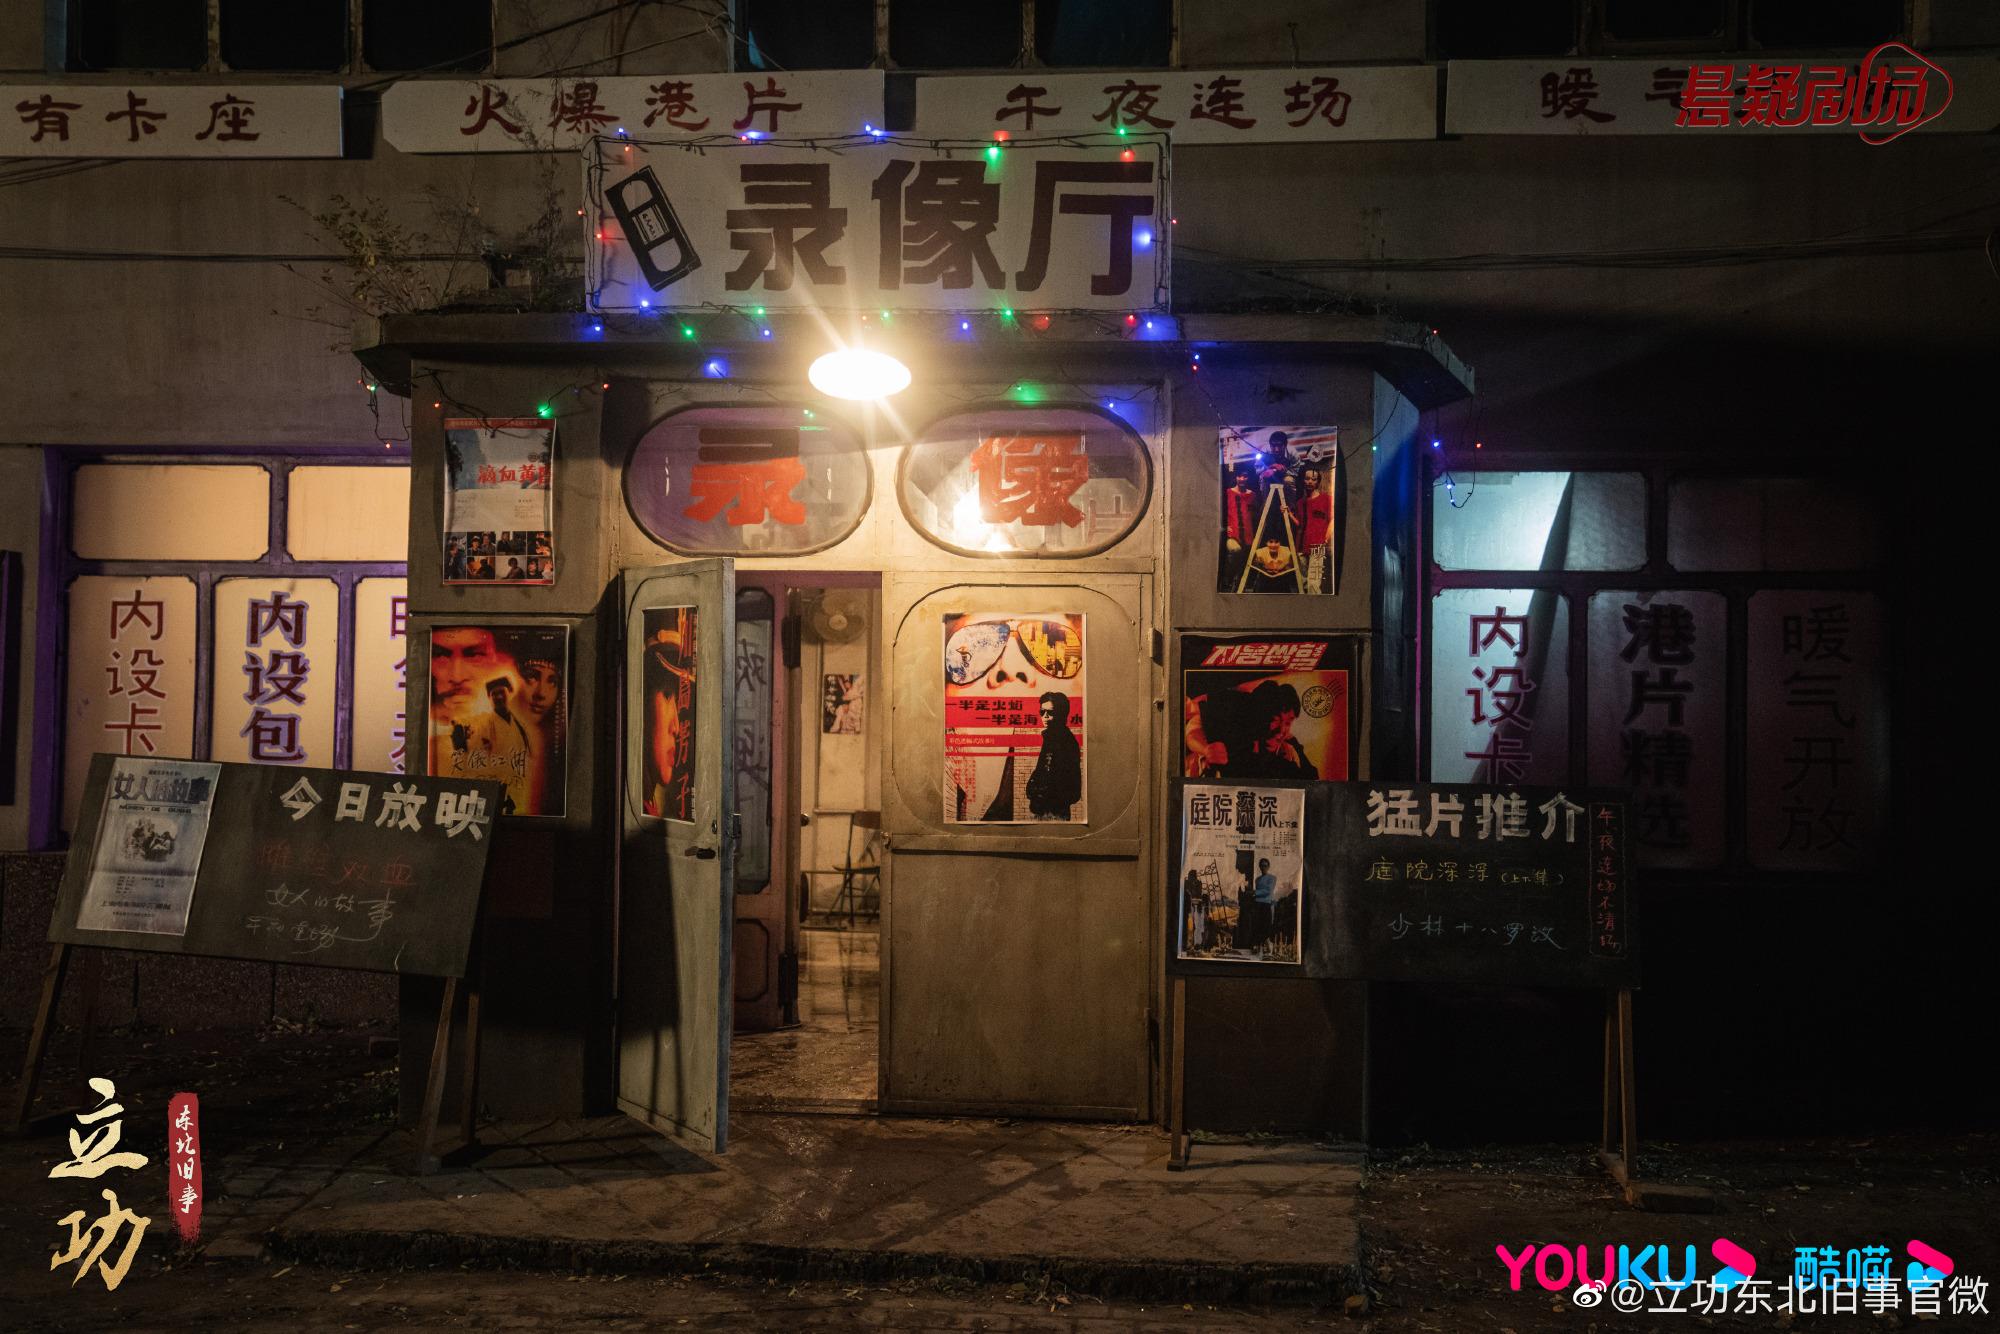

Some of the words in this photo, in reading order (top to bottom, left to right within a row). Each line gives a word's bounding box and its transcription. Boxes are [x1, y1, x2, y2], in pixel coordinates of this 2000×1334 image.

[16, 90, 260, 143] 有卡座
[460, 76, 803, 136] 火爆港片
[995, 76, 1352, 130] 午夜连场
[725, 159, 1155, 296] 录像厅
[682, 427, 806, 527] 录
[971, 429, 1090, 529] 像
[241, 590, 310, 764] 内设包
[1619, 602, 1697, 850] 港片精选
[1777, 602, 1857, 853] 暖气开放
[279, 774, 490, 842] 今日放映
[1365, 788, 1587, 843] 猛片推介
[1365, 855, 1489, 882] 庭院深深
